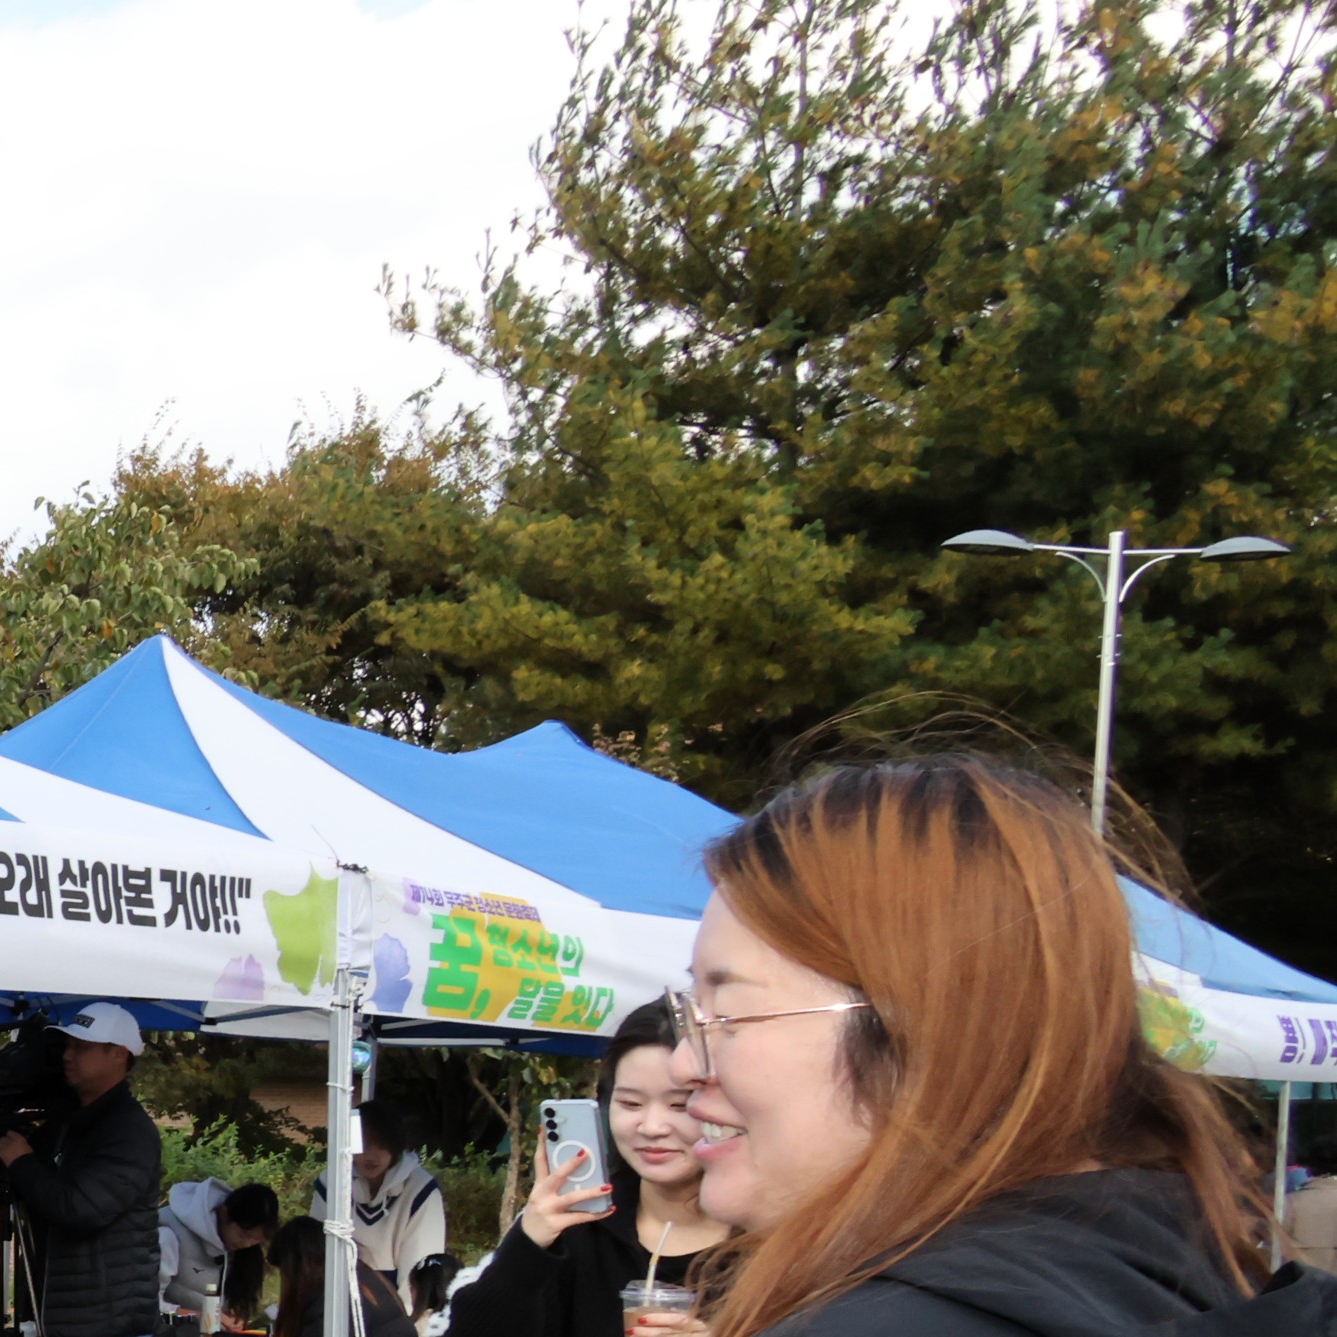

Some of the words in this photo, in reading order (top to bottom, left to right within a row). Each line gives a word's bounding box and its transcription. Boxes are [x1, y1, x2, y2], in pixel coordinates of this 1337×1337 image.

[57, 857, 158, 928] 살아본
[159, 867, 252, 935] 거야!!"
[421, 913, 491, 1020] 꿈,
[486, 924, 584, 978] 청소년의
[507, 977, 565, 1023] 달을
[560, 984, 615, 1028] 잇다
